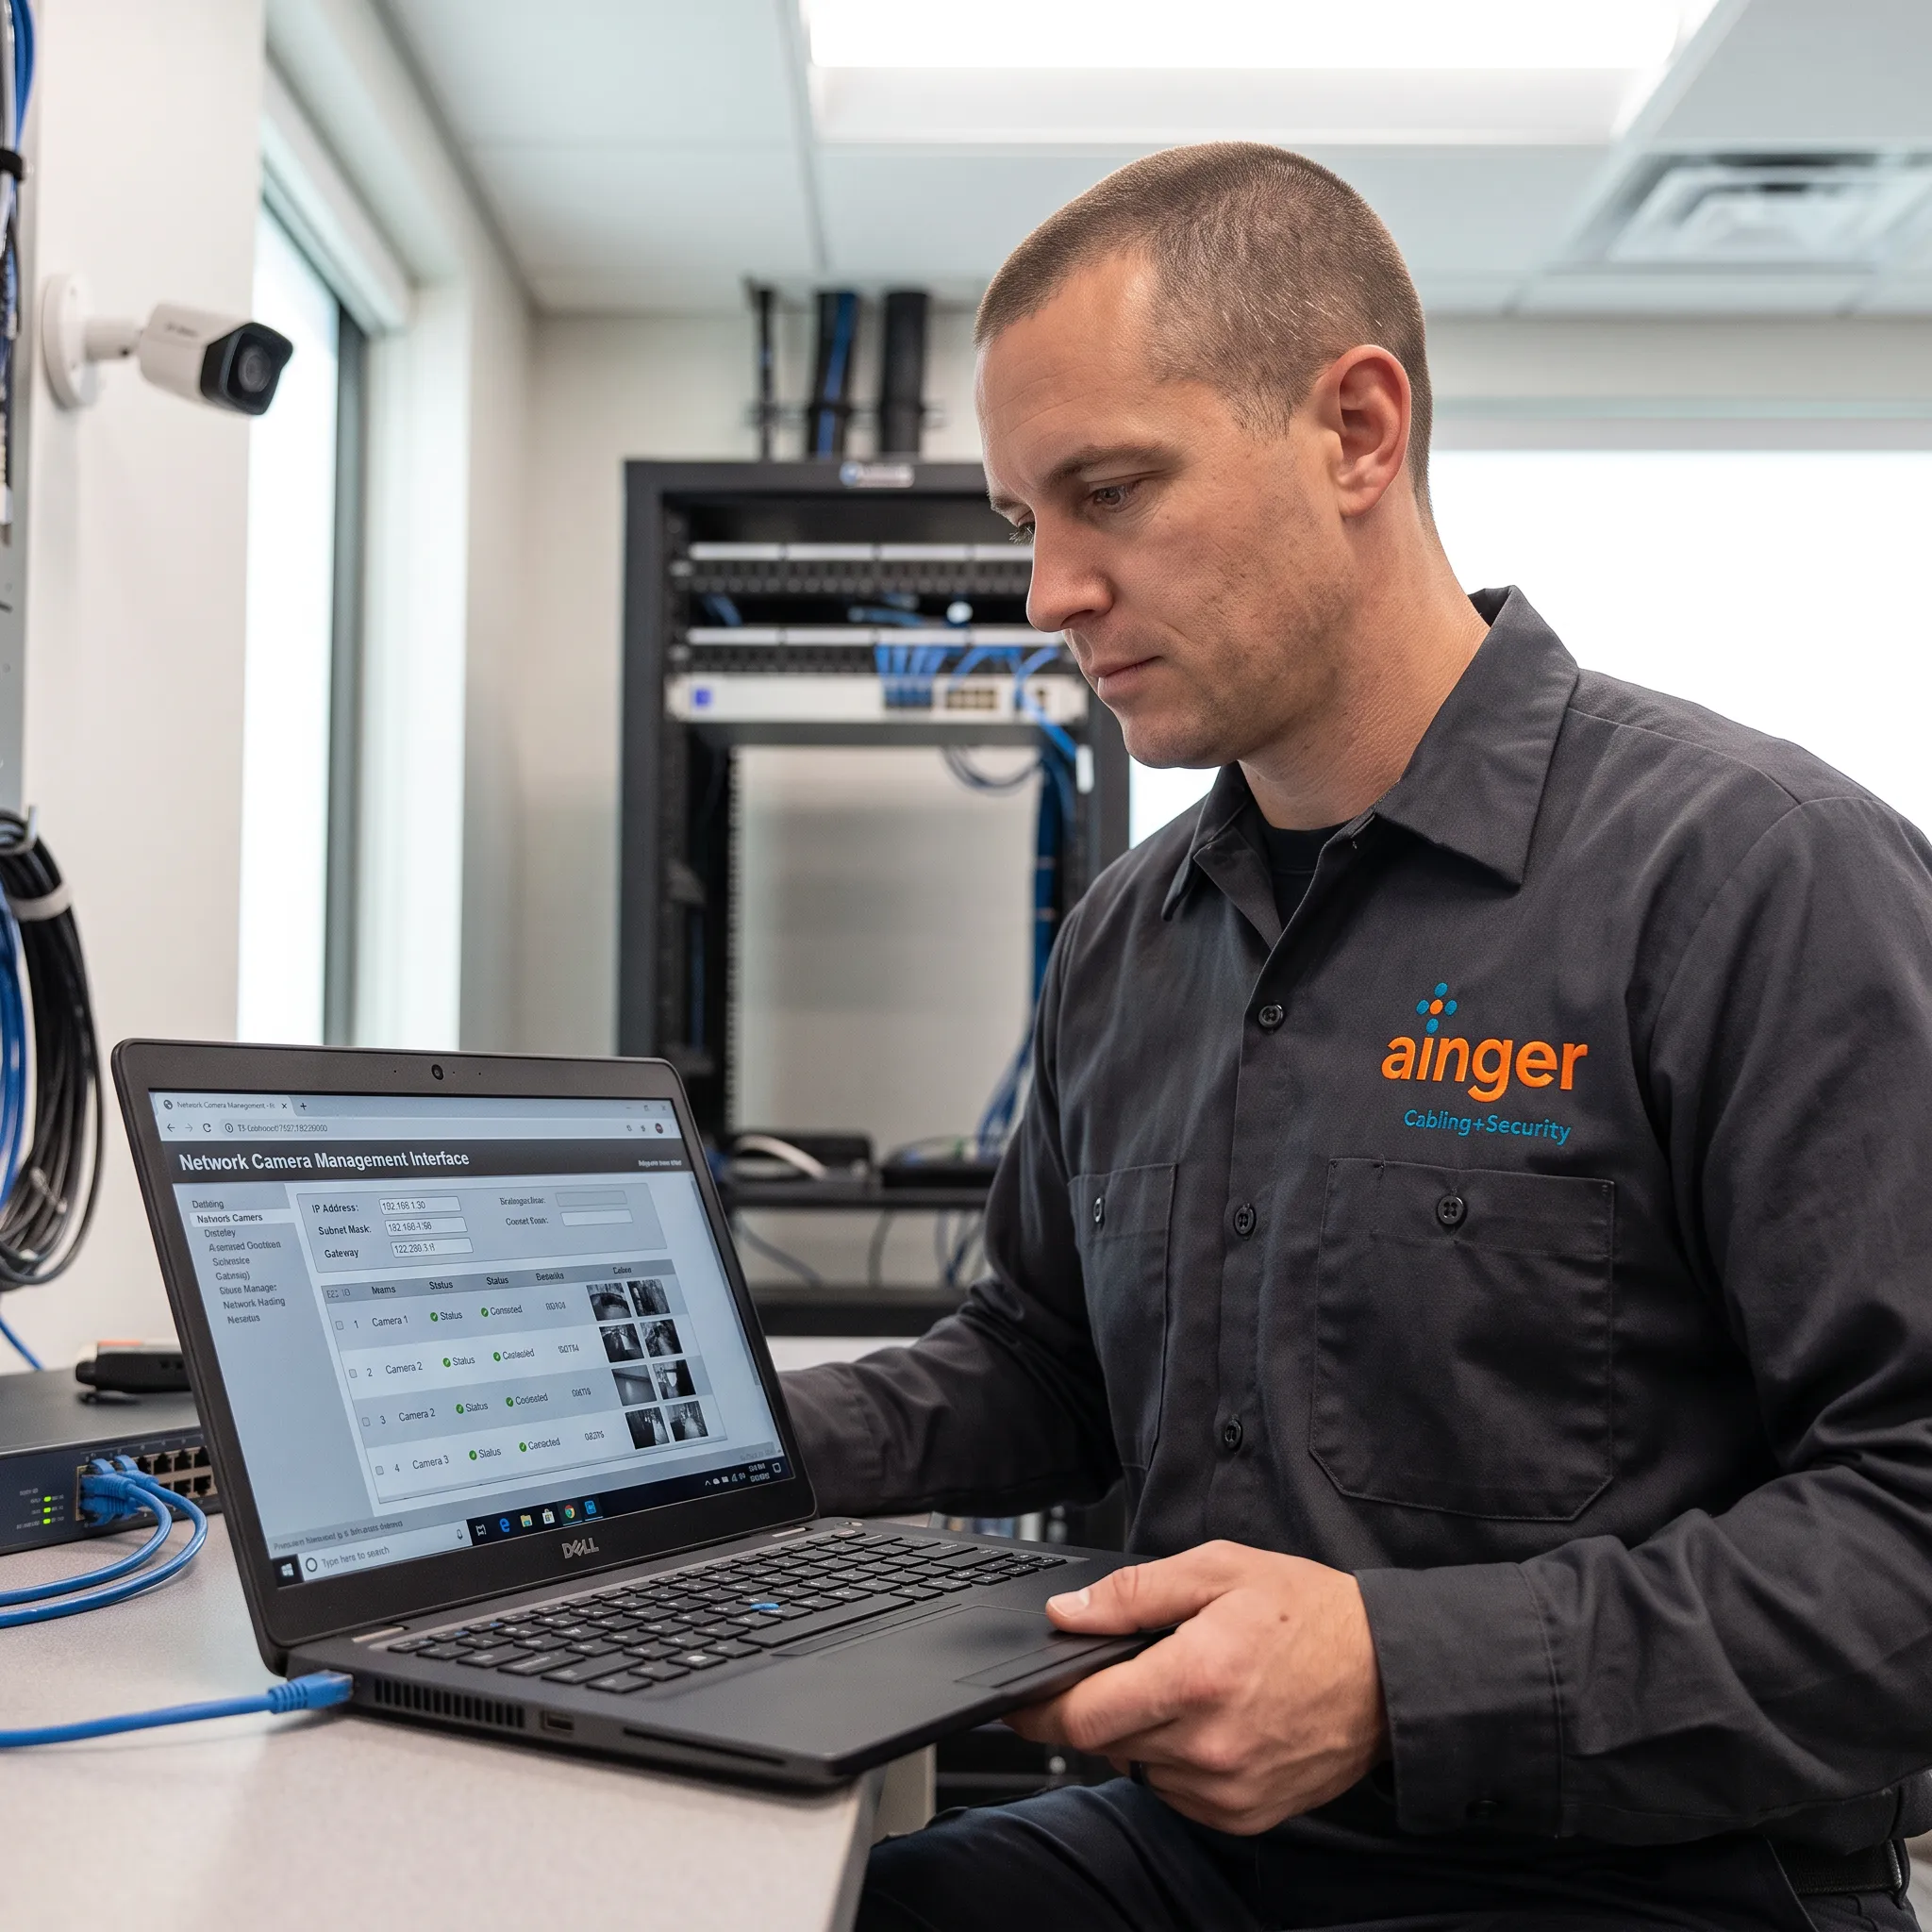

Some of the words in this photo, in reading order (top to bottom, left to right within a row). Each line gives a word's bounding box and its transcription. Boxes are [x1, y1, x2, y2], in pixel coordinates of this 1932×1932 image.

[1380, 1036, 1589, 1103] ainger
[1404, 1109, 1572, 1146] Cabling+Security
[179, 1154, 249, 1171] Network
[251, 1153, 312, 1170] Camera
[314, 1152, 408, 1171] Management
[409, 1151, 470, 1166] Interface
[312, 1205, 321, 1214] IP
[323, 1204, 359, 1213] Address:
[318, 1225, 347, 1236] Subnet
[324, 1248, 358, 1259] Gateway
[223, 1299, 257, 1309] Network
[354, 1320, 359, 1329] 1
[372, 1317, 403, 1327] Camera
[403, 1314, 408, 1324] 1
[366, 1368, 373, 1377] 2
[385, 1363, 416, 1374] Camera
[416, 1361, 424, 1371] 2
[380, 1415, 387, 1424] 3
[398, 1411, 429, 1423] Camera
[429, 1407, 436, 1418] 2
[394, 1463, 400, 1473] 4
[412, 1458, 443, 1470] Camera
[443, 1455, 449, 1465] 3
[561, 1538, 599, 1559] DELL
